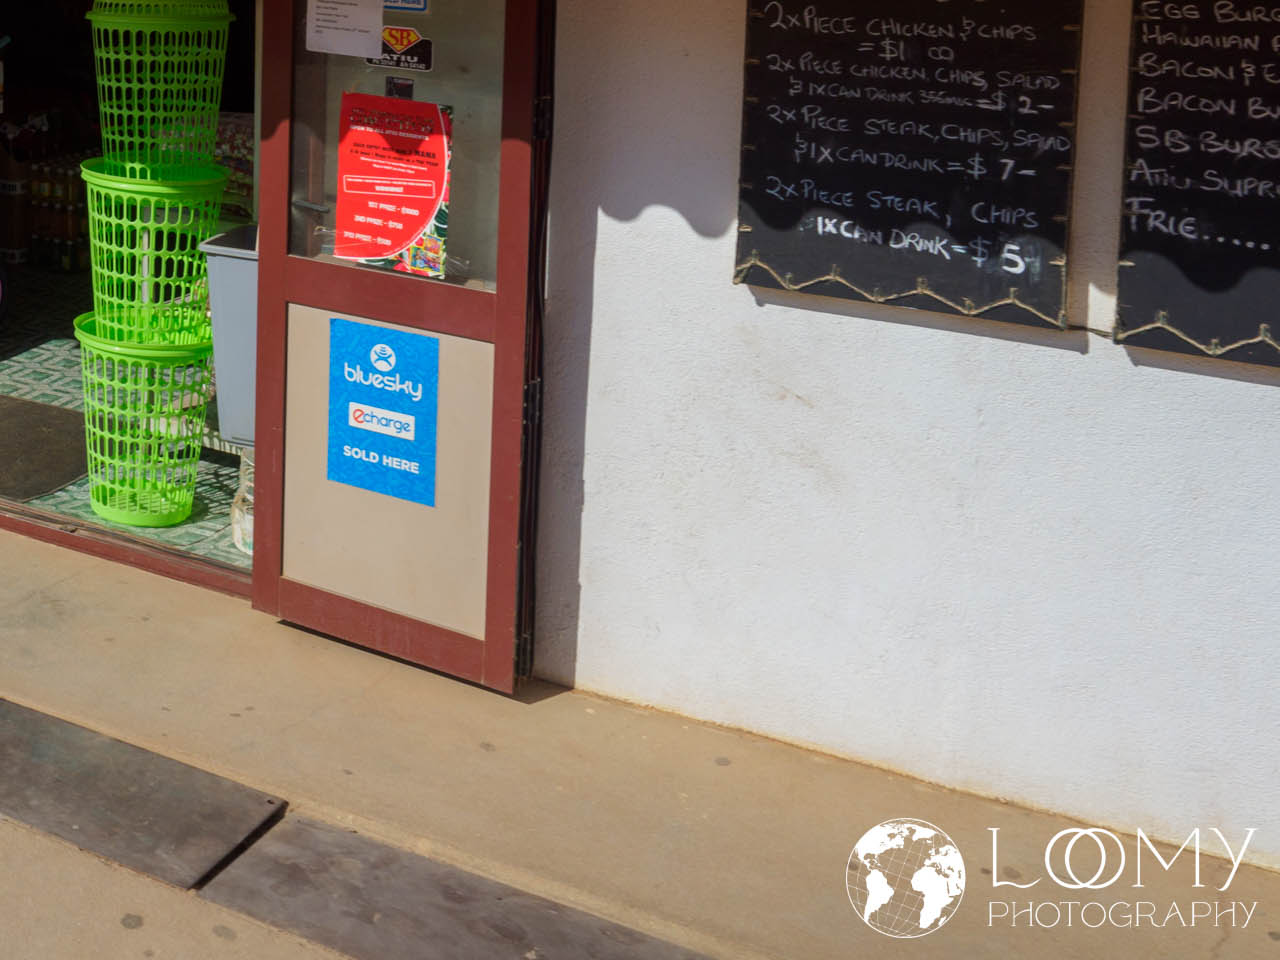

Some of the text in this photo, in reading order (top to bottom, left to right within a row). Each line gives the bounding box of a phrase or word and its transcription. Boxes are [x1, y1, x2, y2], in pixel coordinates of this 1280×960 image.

[1141, 0, 1200, 20] EGG
[1138, 52, 1235, 80] BACON
[1137, 86, 1236, 116] BACON
[344, 361, 423, 402] bluesky
[352, 408, 411, 434] echarge
[343, 444, 420, 474] SOLD HERE
